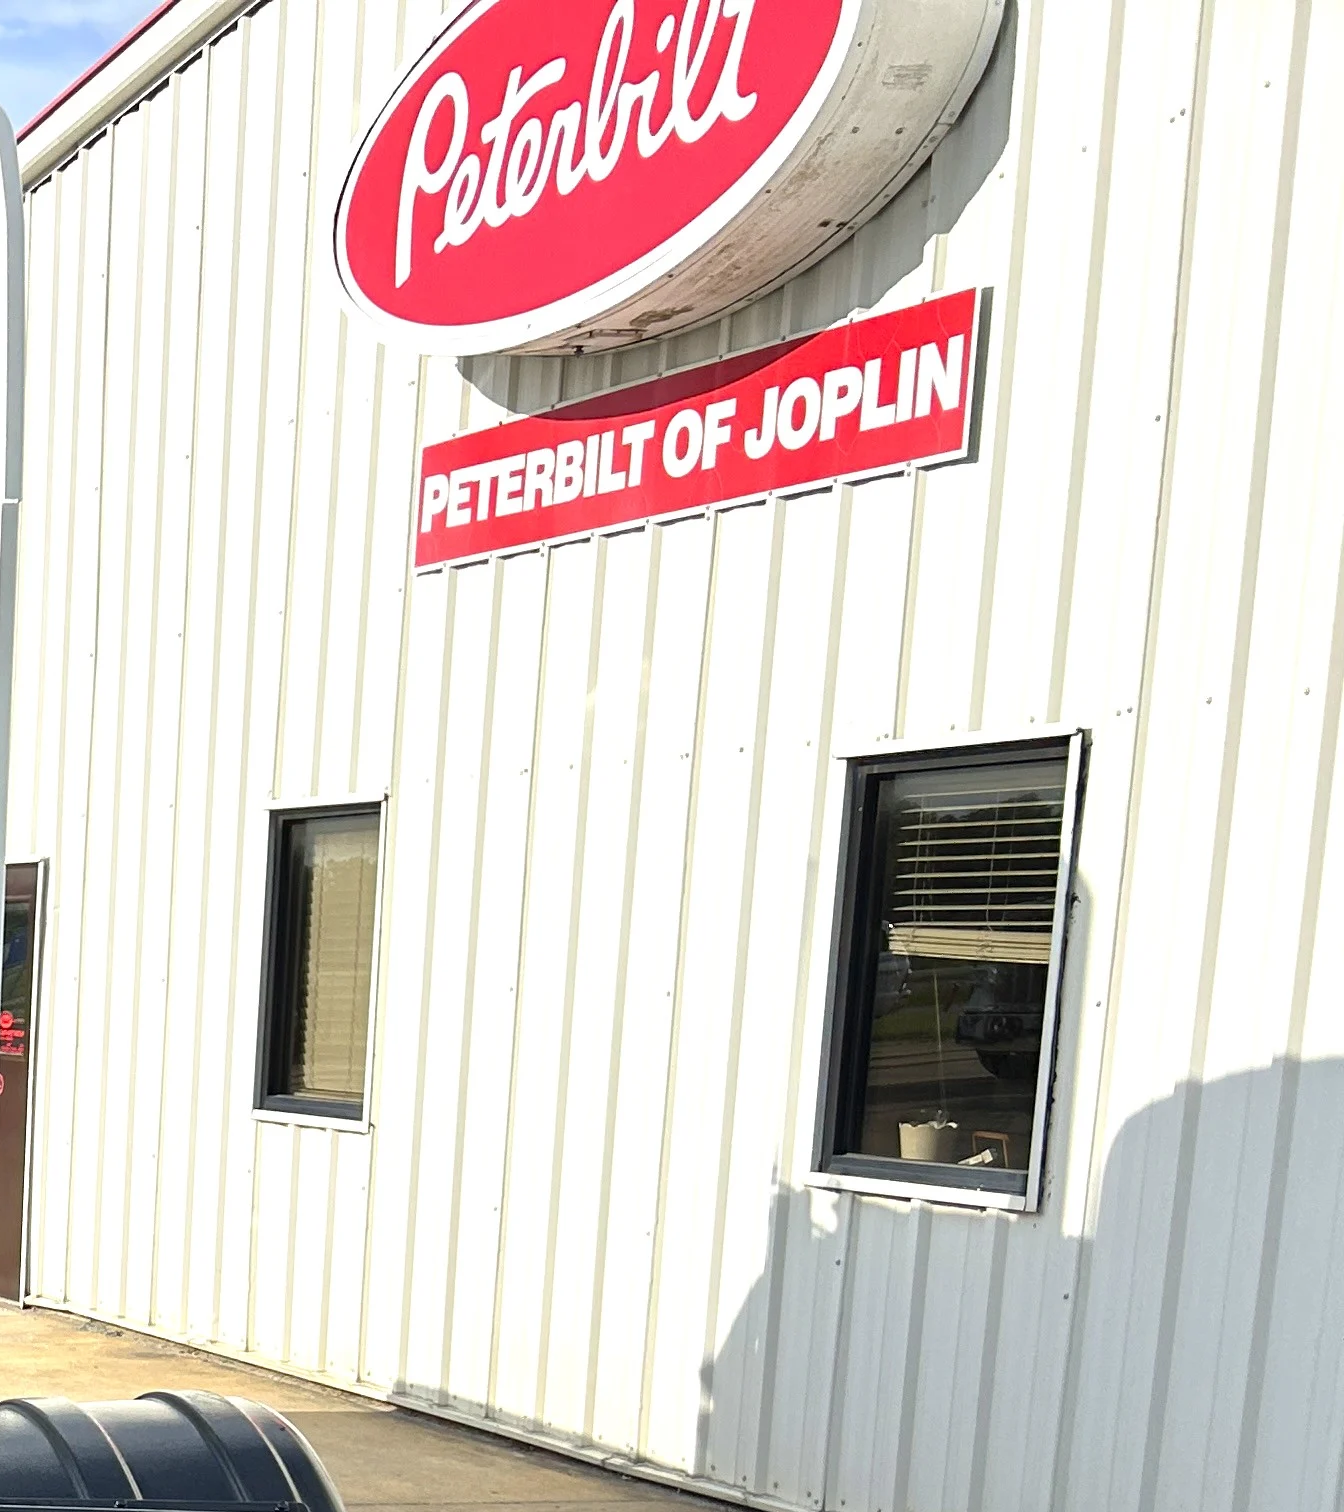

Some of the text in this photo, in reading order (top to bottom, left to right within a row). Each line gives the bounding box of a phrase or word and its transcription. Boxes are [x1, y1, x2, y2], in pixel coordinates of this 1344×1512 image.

[395, 0, 758, 288] Peterbilt
[419, 334, 964, 532] PETERBILT OF JOPLIN
